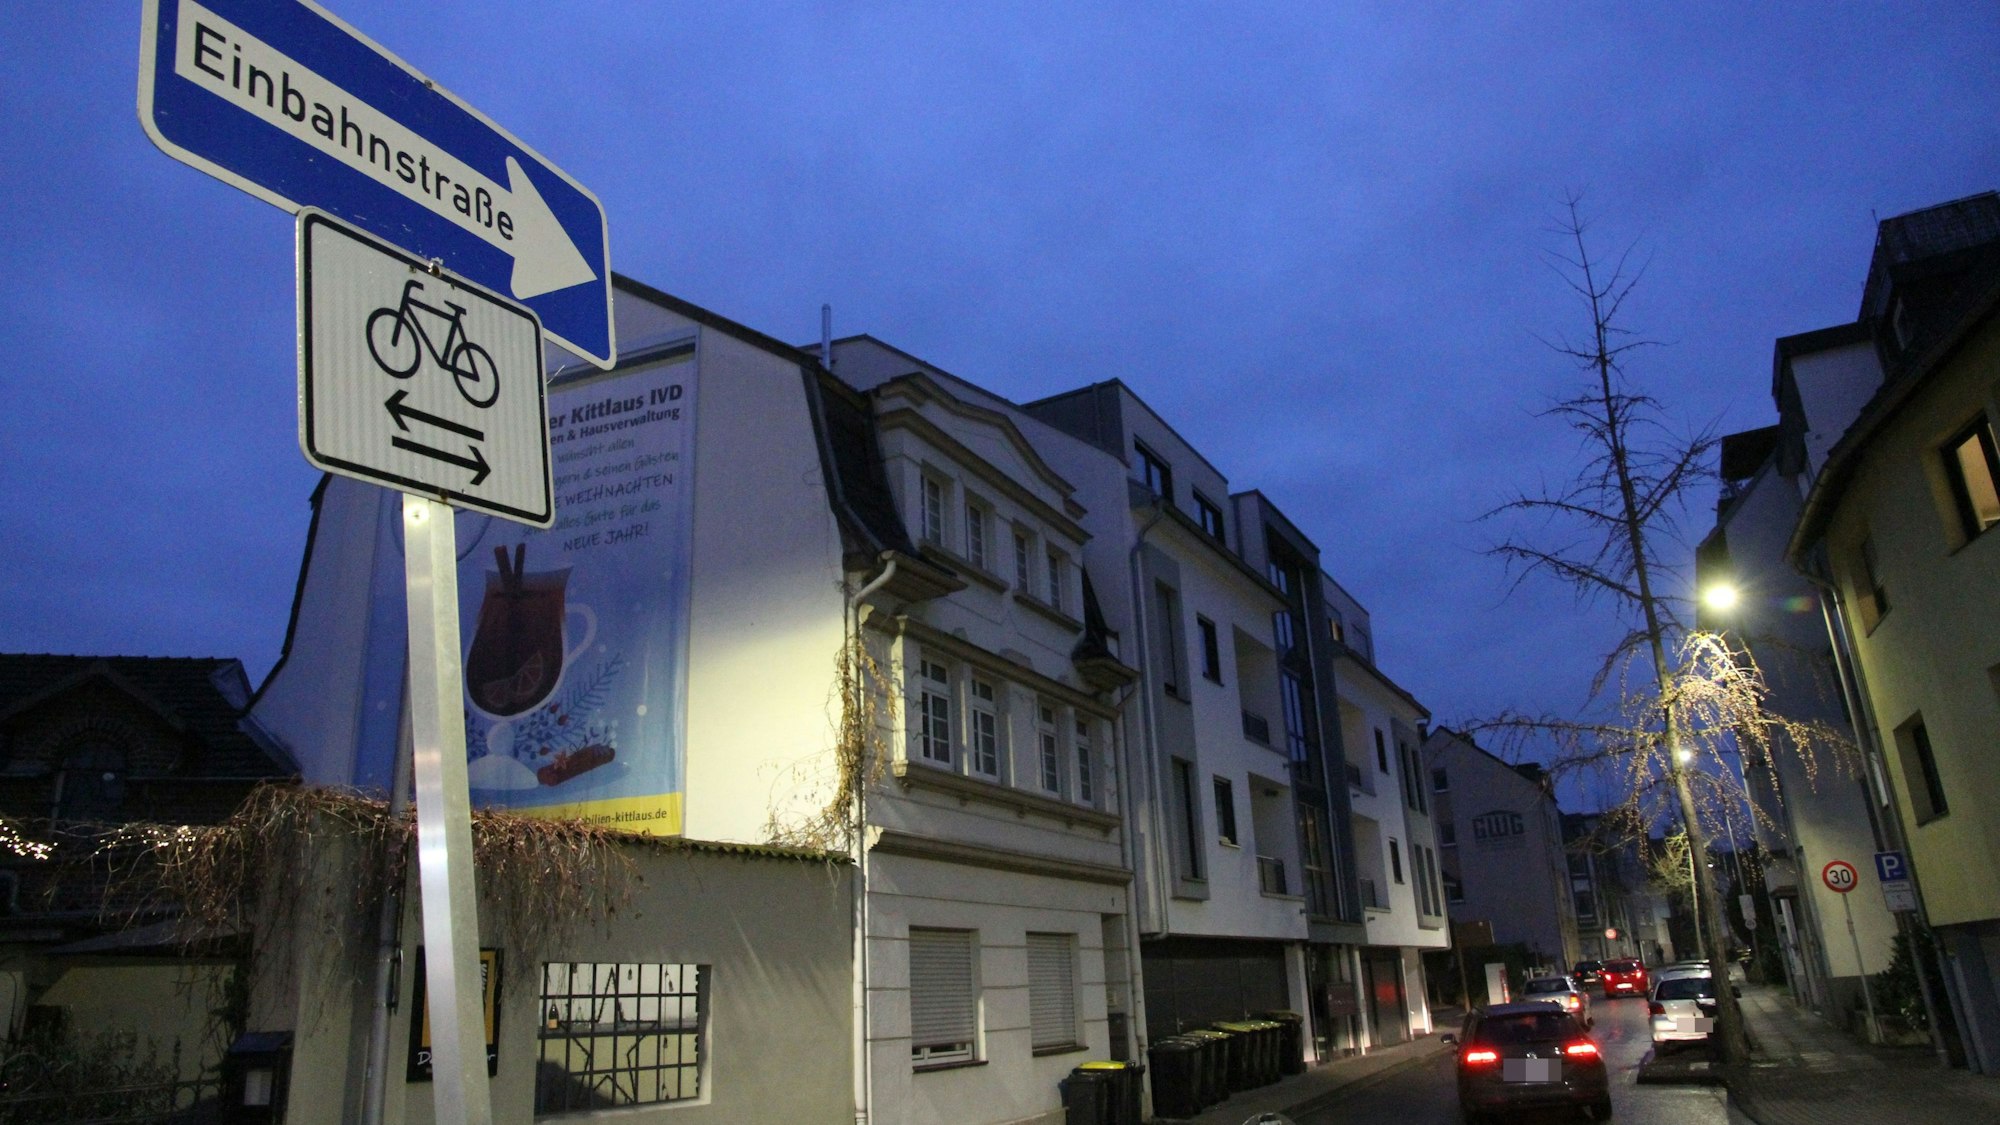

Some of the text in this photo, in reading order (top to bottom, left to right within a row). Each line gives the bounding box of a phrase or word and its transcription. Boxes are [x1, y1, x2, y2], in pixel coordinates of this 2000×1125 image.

[194, 21, 514, 241] Einbahnstraße
[549, 384, 683, 430] er Kittlaus IVD
[550, 408, 681, 446] en & Hausverwaltung
[595, 462, 631, 477] seinen
[565, 473, 674, 507] WEIHNACHTEN
[640, 498, 662, 514] das
[563, 532, 600, 552] NEUE
[604, 521, 649, 545] JAHR!
[583, 808, 667, 826] bilien-kittlaus.de
[1829, 868, 1851, 884] 30
[1881, 855, 1899, 878] P
